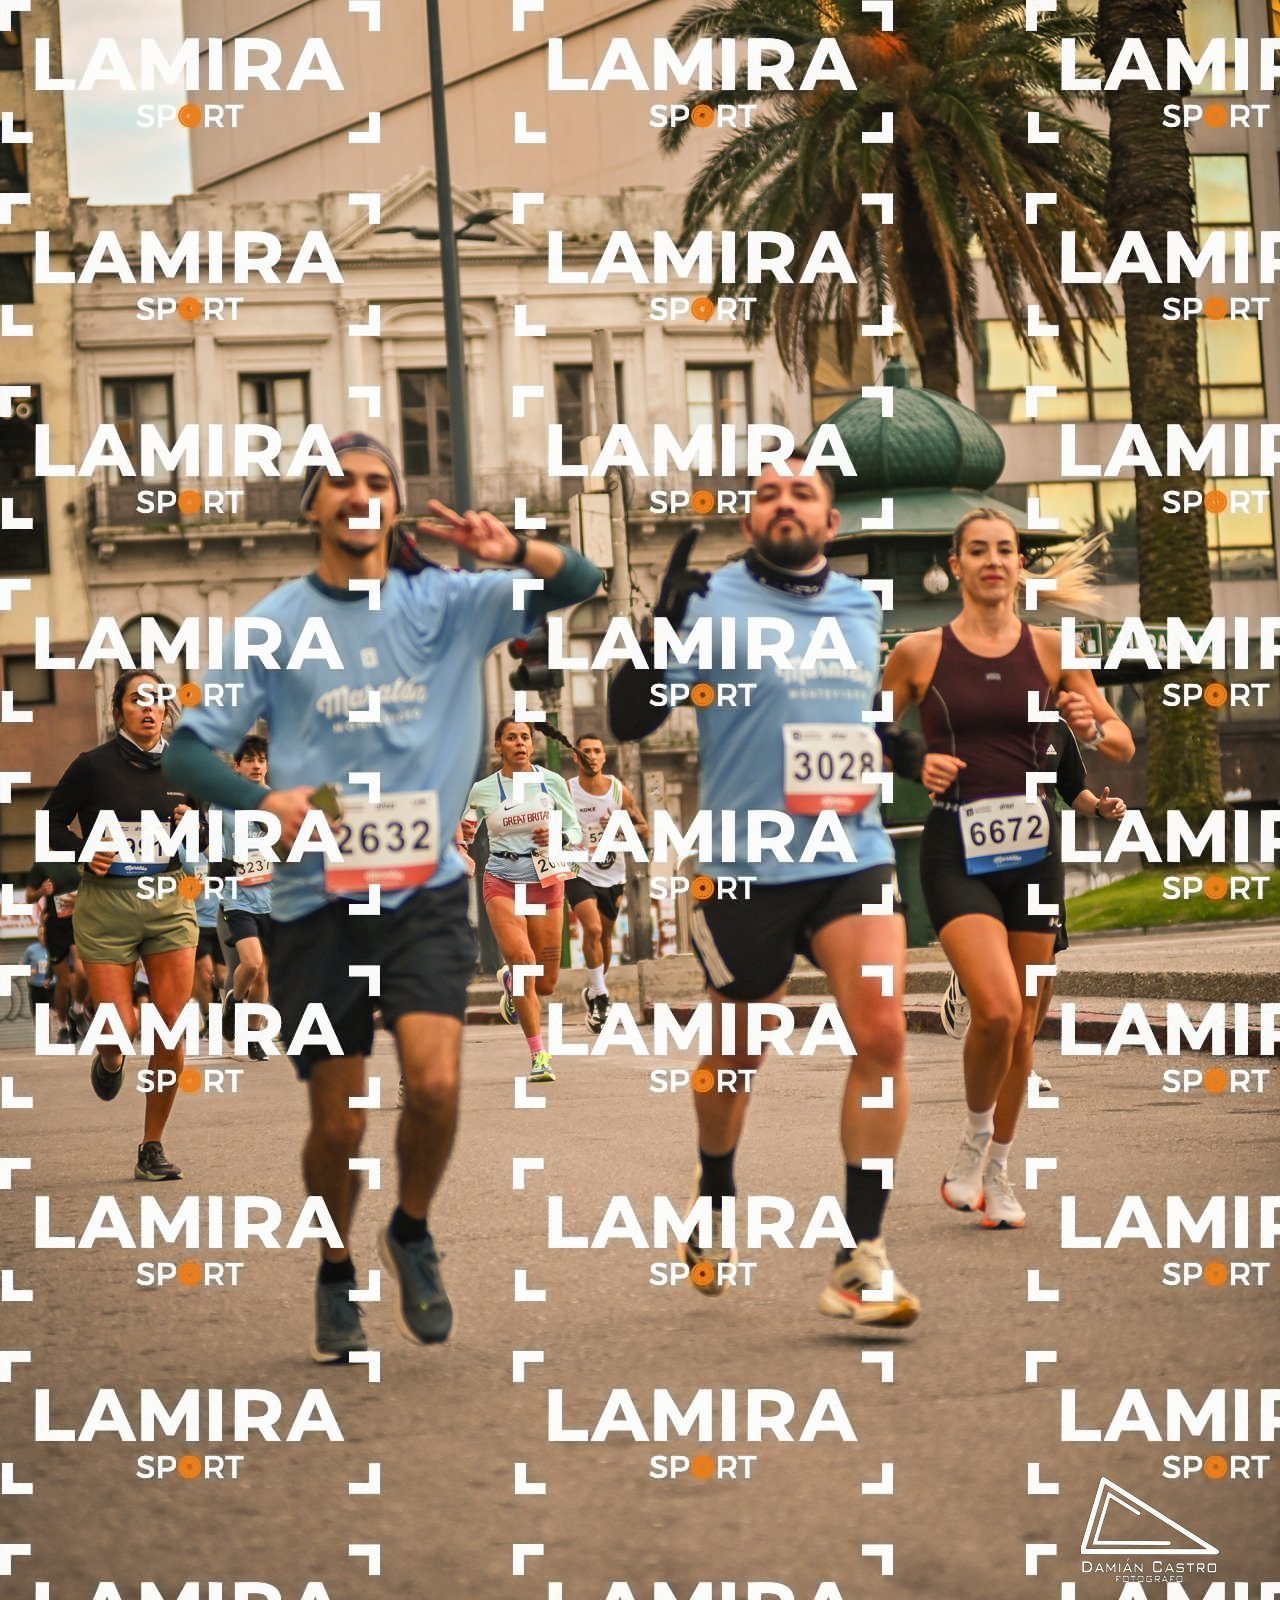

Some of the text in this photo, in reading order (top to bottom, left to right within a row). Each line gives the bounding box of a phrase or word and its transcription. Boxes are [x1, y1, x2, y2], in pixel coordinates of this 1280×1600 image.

[794, 751, 874, 781] 3028
[503, 810, 550, 827] GREAT BRITA
[970, 815, 1044, 847] 6672
[336, 818, 430, 854] 2632
